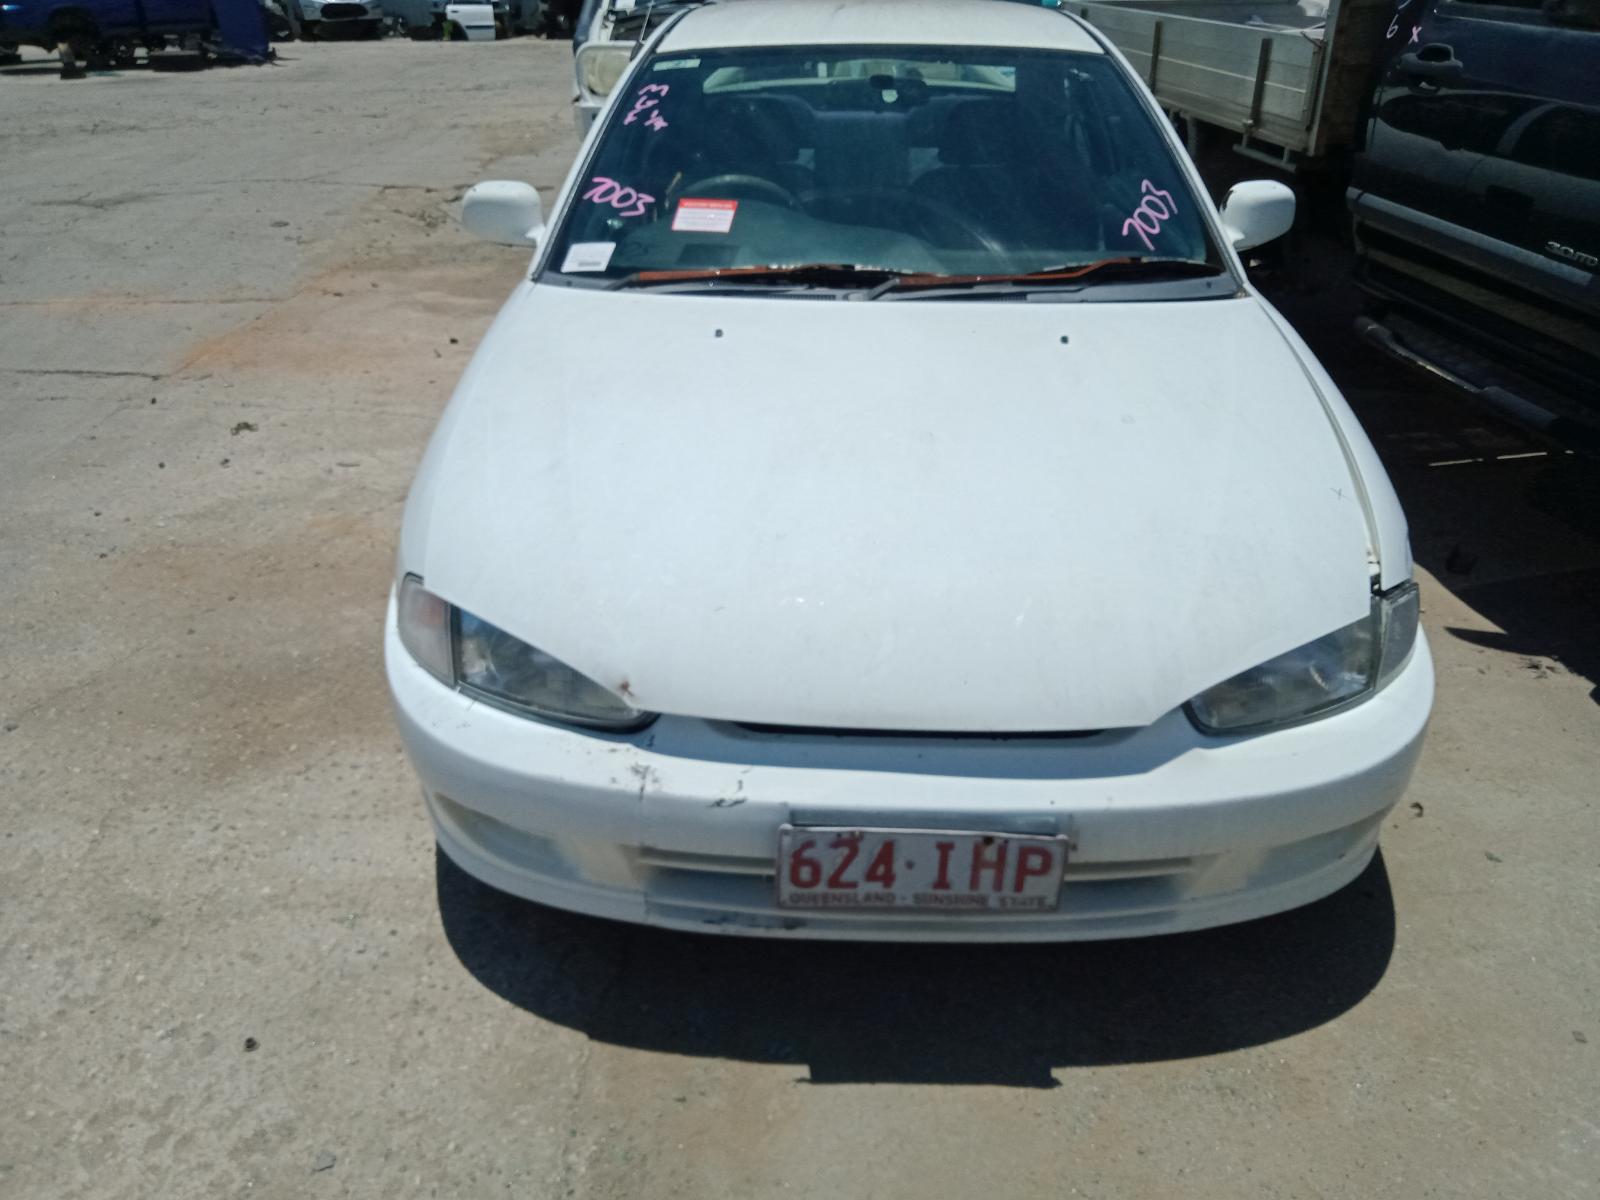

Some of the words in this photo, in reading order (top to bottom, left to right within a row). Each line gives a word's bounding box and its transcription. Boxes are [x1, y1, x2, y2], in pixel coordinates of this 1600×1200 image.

[583, 176, 656, 217] 7003
[1121, 178, 1179, 251] 7003
[788, 891, 897, 907] QUEENSLAND
[912, 893, 990, 908] SUNSHINE
[998, 895, 1048, 910] STATE
